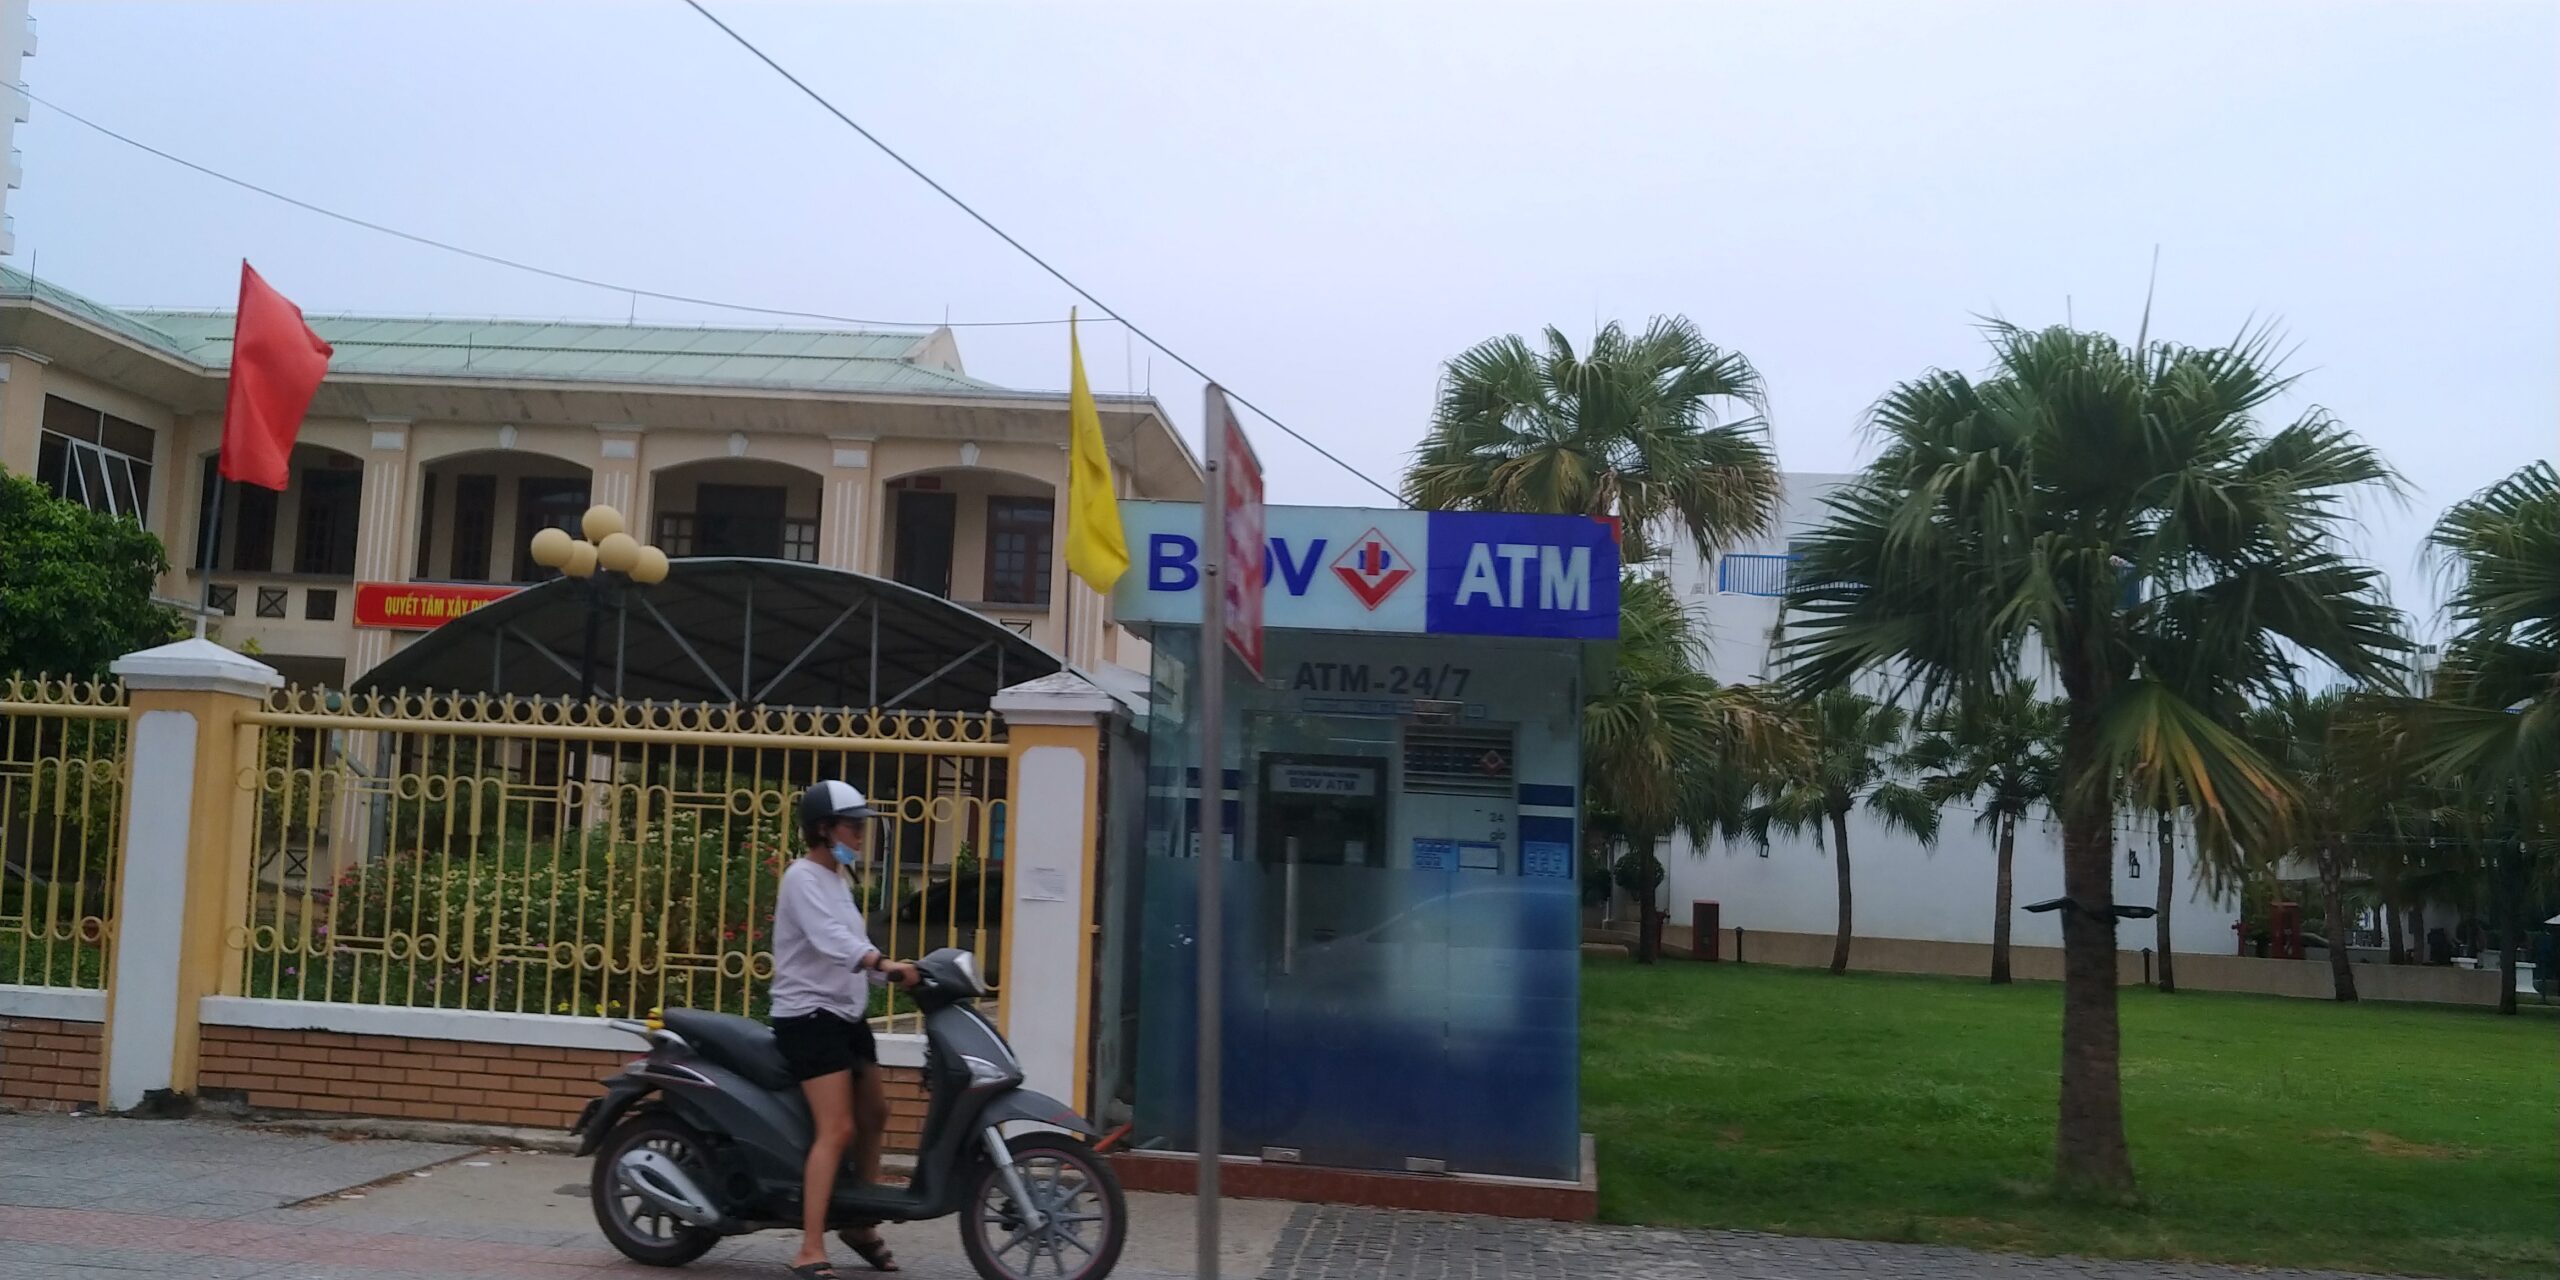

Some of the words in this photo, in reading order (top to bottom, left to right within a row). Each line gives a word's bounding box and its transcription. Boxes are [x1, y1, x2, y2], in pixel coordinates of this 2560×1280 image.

[1148, 533, 1328, 596] BV
[1455, 542, 1592, 611] ATM
[384, 592, 419, 618] QUYẾT
[421, 594, 445, 617] TÂM
[446, 595, 469, 618] XÂY
[1326, 780, 1356, 791] ATM
